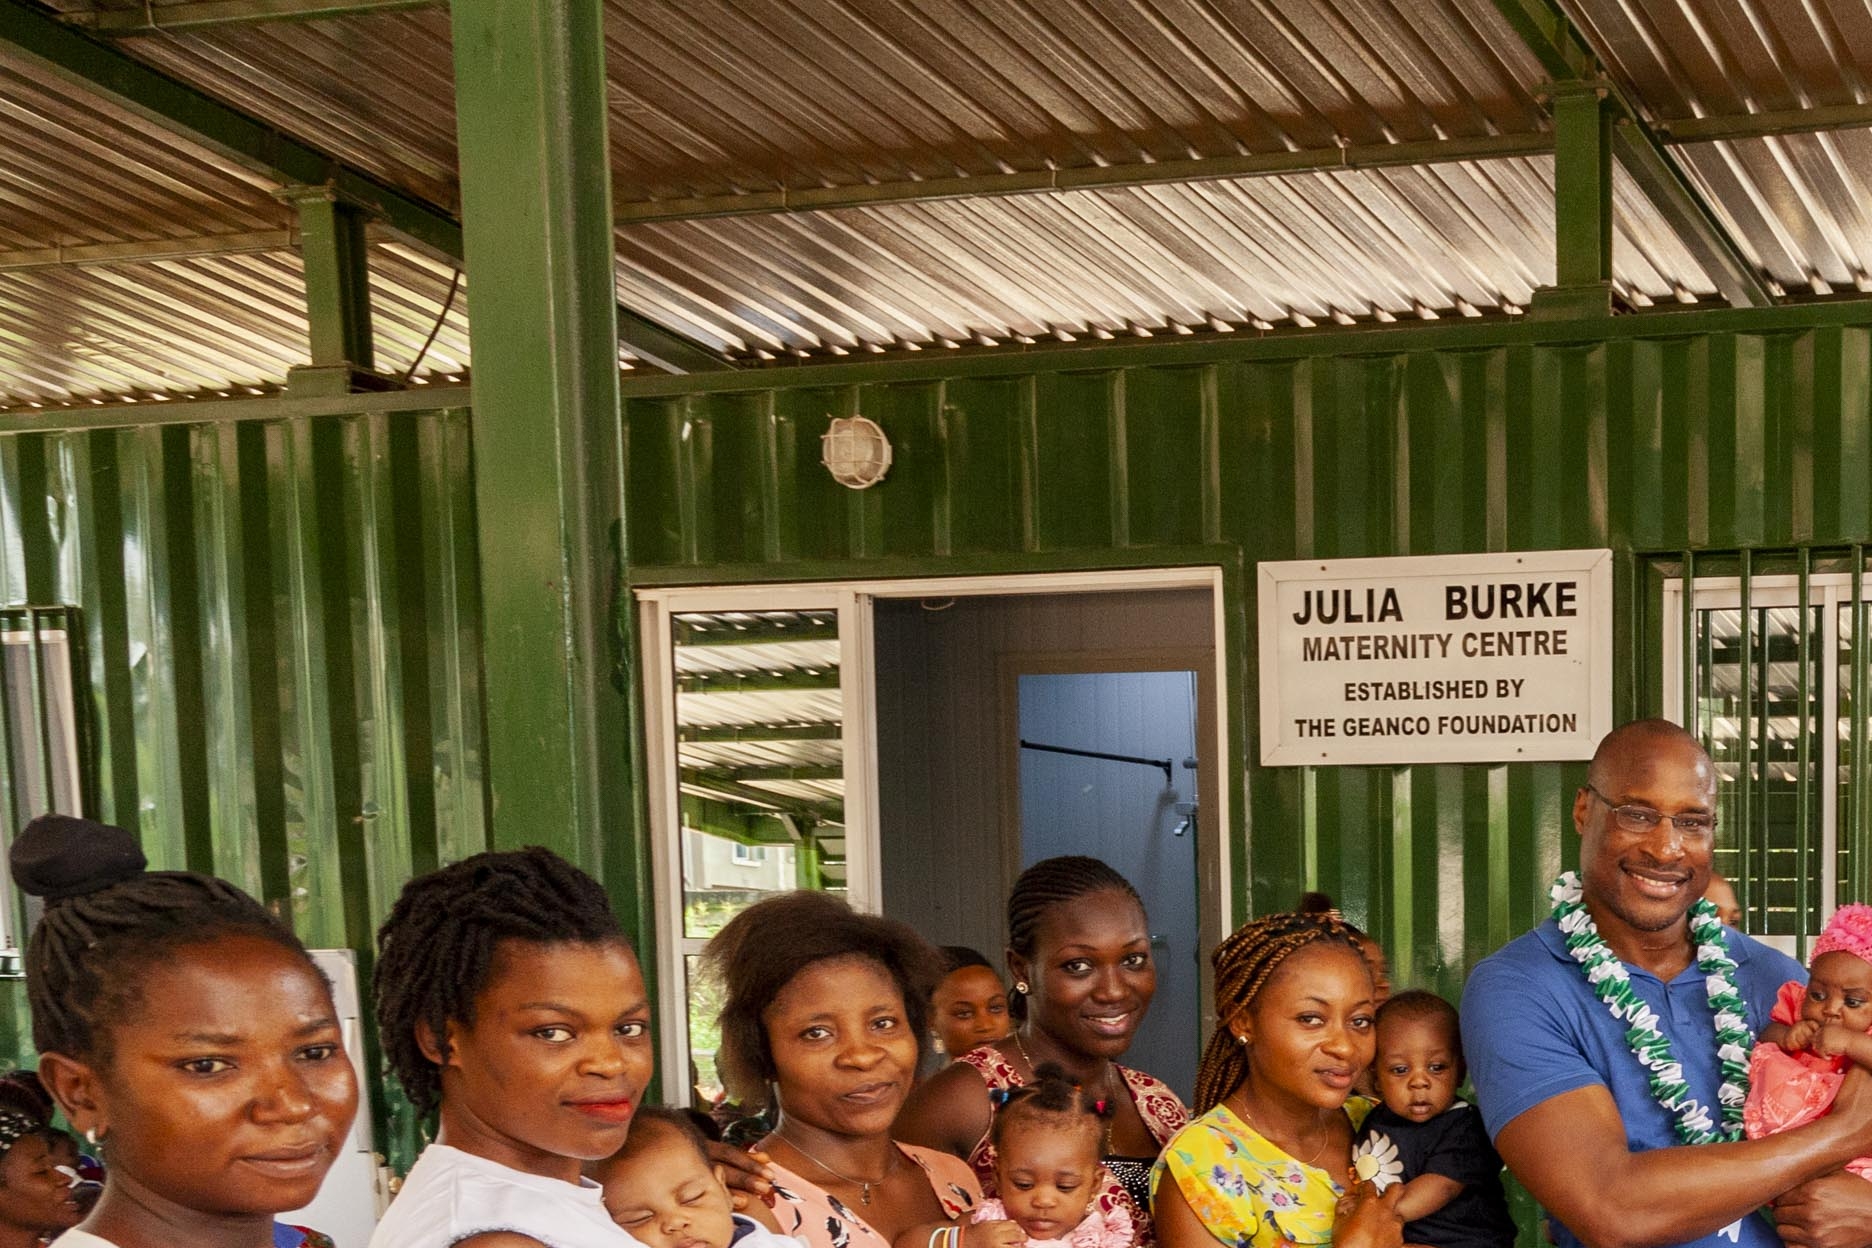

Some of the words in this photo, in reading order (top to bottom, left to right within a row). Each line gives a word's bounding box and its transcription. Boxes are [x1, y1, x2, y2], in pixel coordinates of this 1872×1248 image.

[1293, 587, 1403, 625] JULIA
[1445, 581, 1577, 620] BURKE
[1303, 633, 1453, 662] MATERNITY
[1462, 630, 1568, 657] CENTRE
[1344, 679, 1489, 702] ESTABLISHED
[1496, 678, 1525, 698] BY
[1294, 718, 1336, 738] THE
[1342, 716, 1430, 737] GEANCO
[1438, 713, 1577, 735] FOUNDATION
